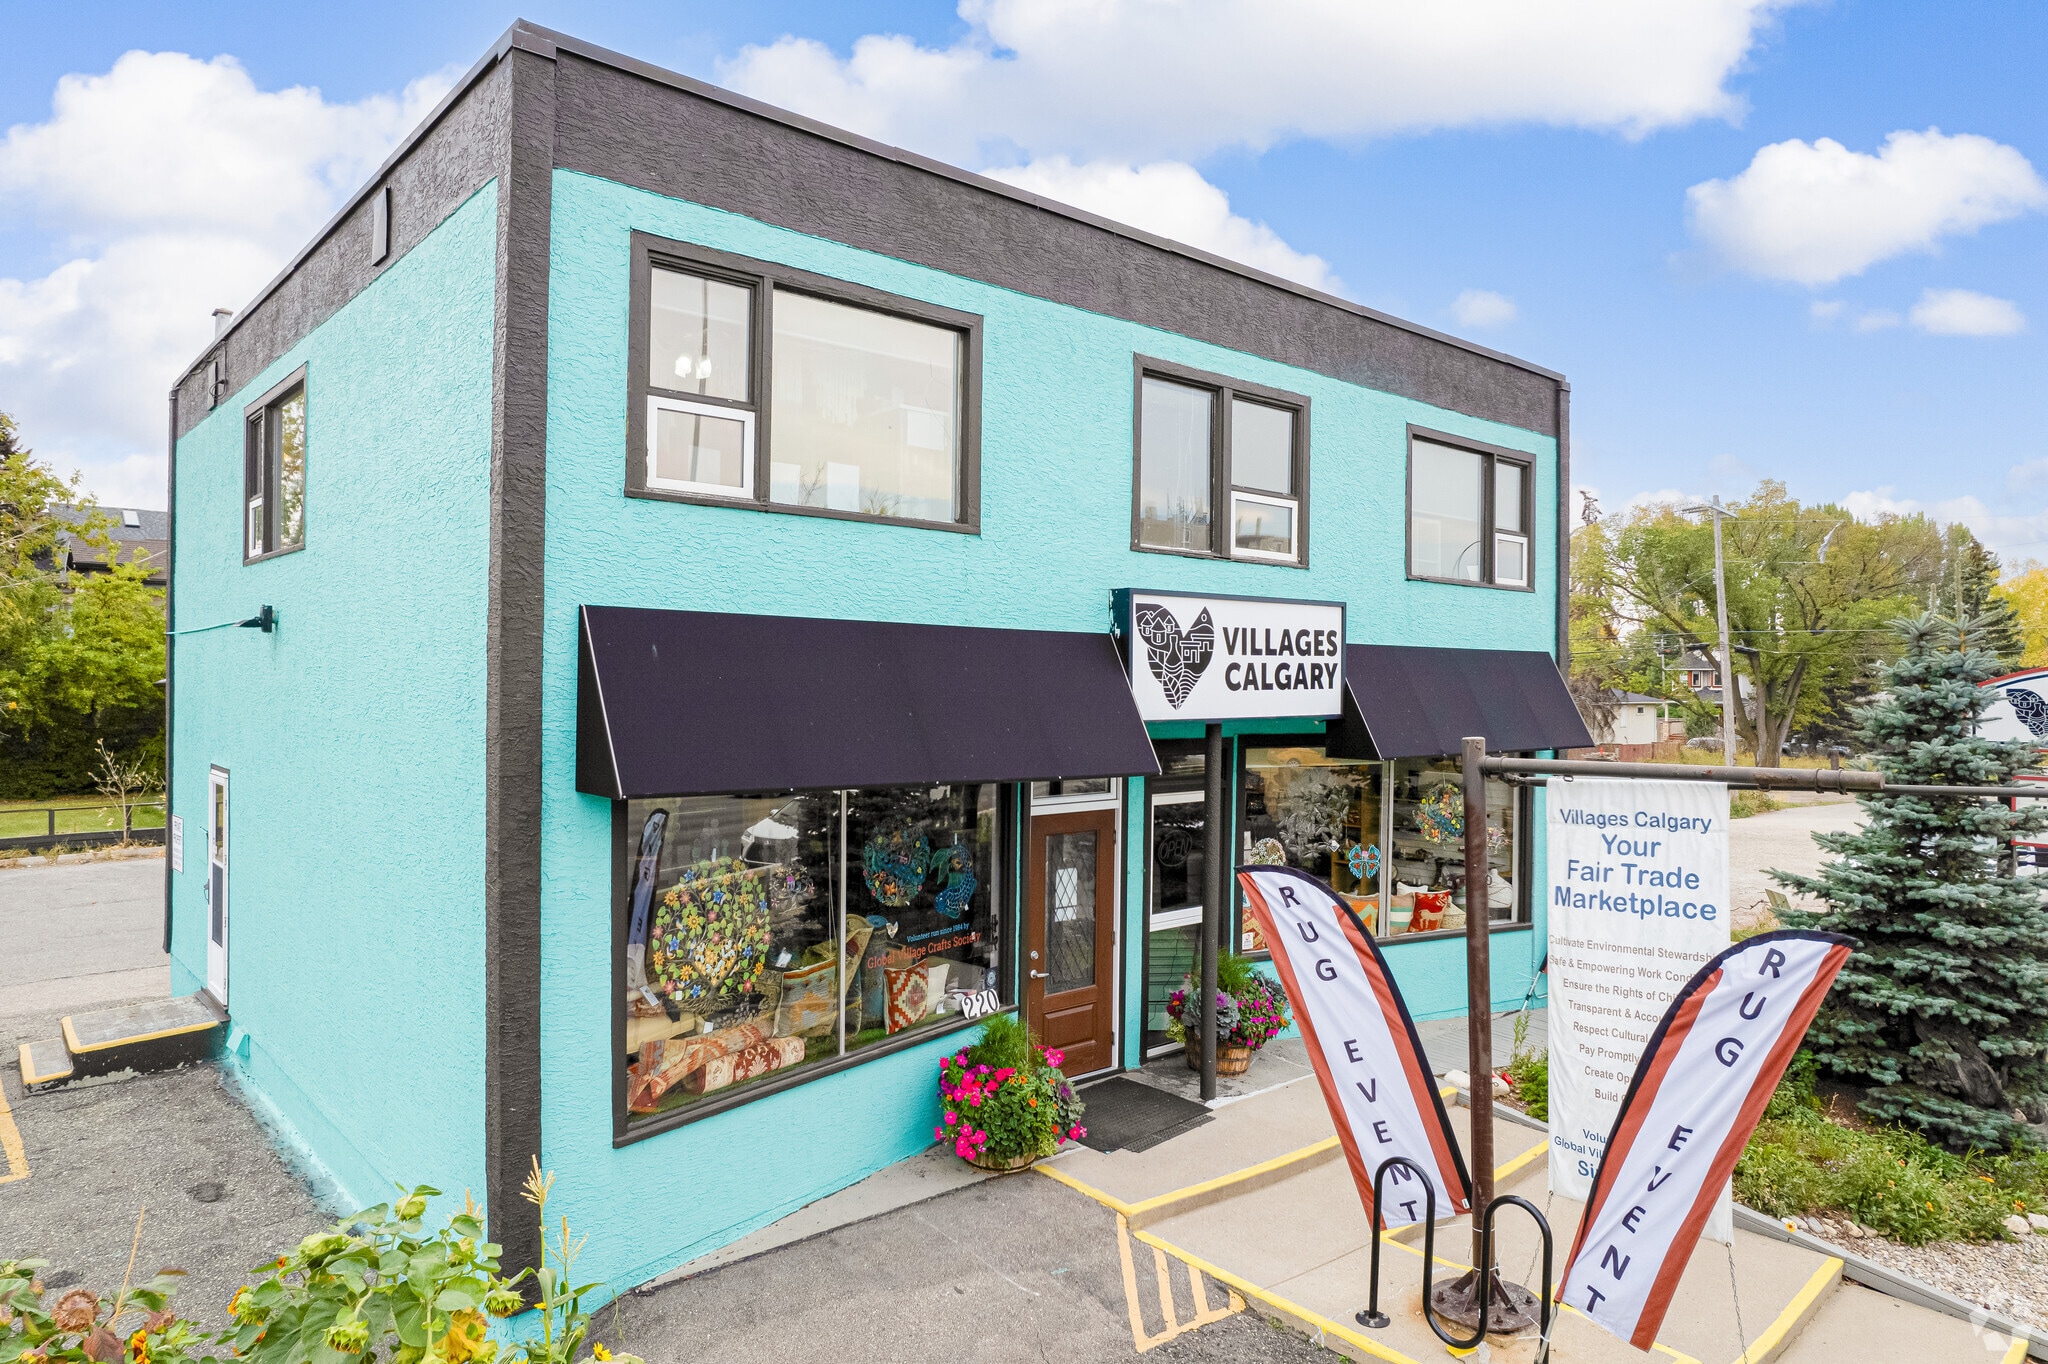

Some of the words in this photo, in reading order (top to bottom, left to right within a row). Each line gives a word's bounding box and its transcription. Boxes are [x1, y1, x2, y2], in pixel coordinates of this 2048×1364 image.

[1223, 626, 1338, 657] VILLAGES
[1225, 661, 1338, 691] CALGARY
[1559, 808, 1629, 829] Villages
[1634, 811, 1712, 834] Calgary
[1160, 838, 1190, 859] OPEN
[1601, 833, 1661, 857] Your
[1567, 859, 1614, 882] Fair
[1621, 862, 1700, 890] Trade
[1554, 885, 1717, 921] Marketplace
[867, 949, 895, 969] Global
[898, 946, 926, 961] Village
[927, 938, 952, 954] Crafts
[1549, 934, 1584, 949] Cultivate
[1587, 939, 1655, 957] Environmental
[1549, 954, 1566, 967] Safe
[1568, 958, 1574, 968] &
[1576, 959, 1635, 978] Empowering
[1637, 967, 1662, 980] Work
[1665, 970, 1695, 983] Cond
[1563, 978, 1593, 992] Ensure
[1595, 984, 1610, 995] the
[1613, 986, 1643, 999] Rights
[1646, 990, 1656, 1001] of
[963, 989, 998, 1019] 220
[1568, 999, 1622, 1018] Transparent
[1625, 1008, 1632, 1019] &
[1634, 1010, 1661, 1023] Acco
[1714, 947, 1786, 1068] RUG
[1573, 1021, 1609, 1037] Respect
[1611, 1028, 1649, 1043] Cultural
[1279, 885, 1338, 982] RUG
[1343, 1038, 1418, 1222] EVENT
[1579, 1043, 1595, 1058] Pay
[1597, 1047, 1640, 1065] Promptly
[1584, 1065, 1614, 1080] Create
[1616, 1071, 1632, 1085] Op
[1594, 1088, 1618, 1102] Build
[1554, 1135, 1586, 1155] Global
[1586, 1124, 1694, 1314] EVENT
